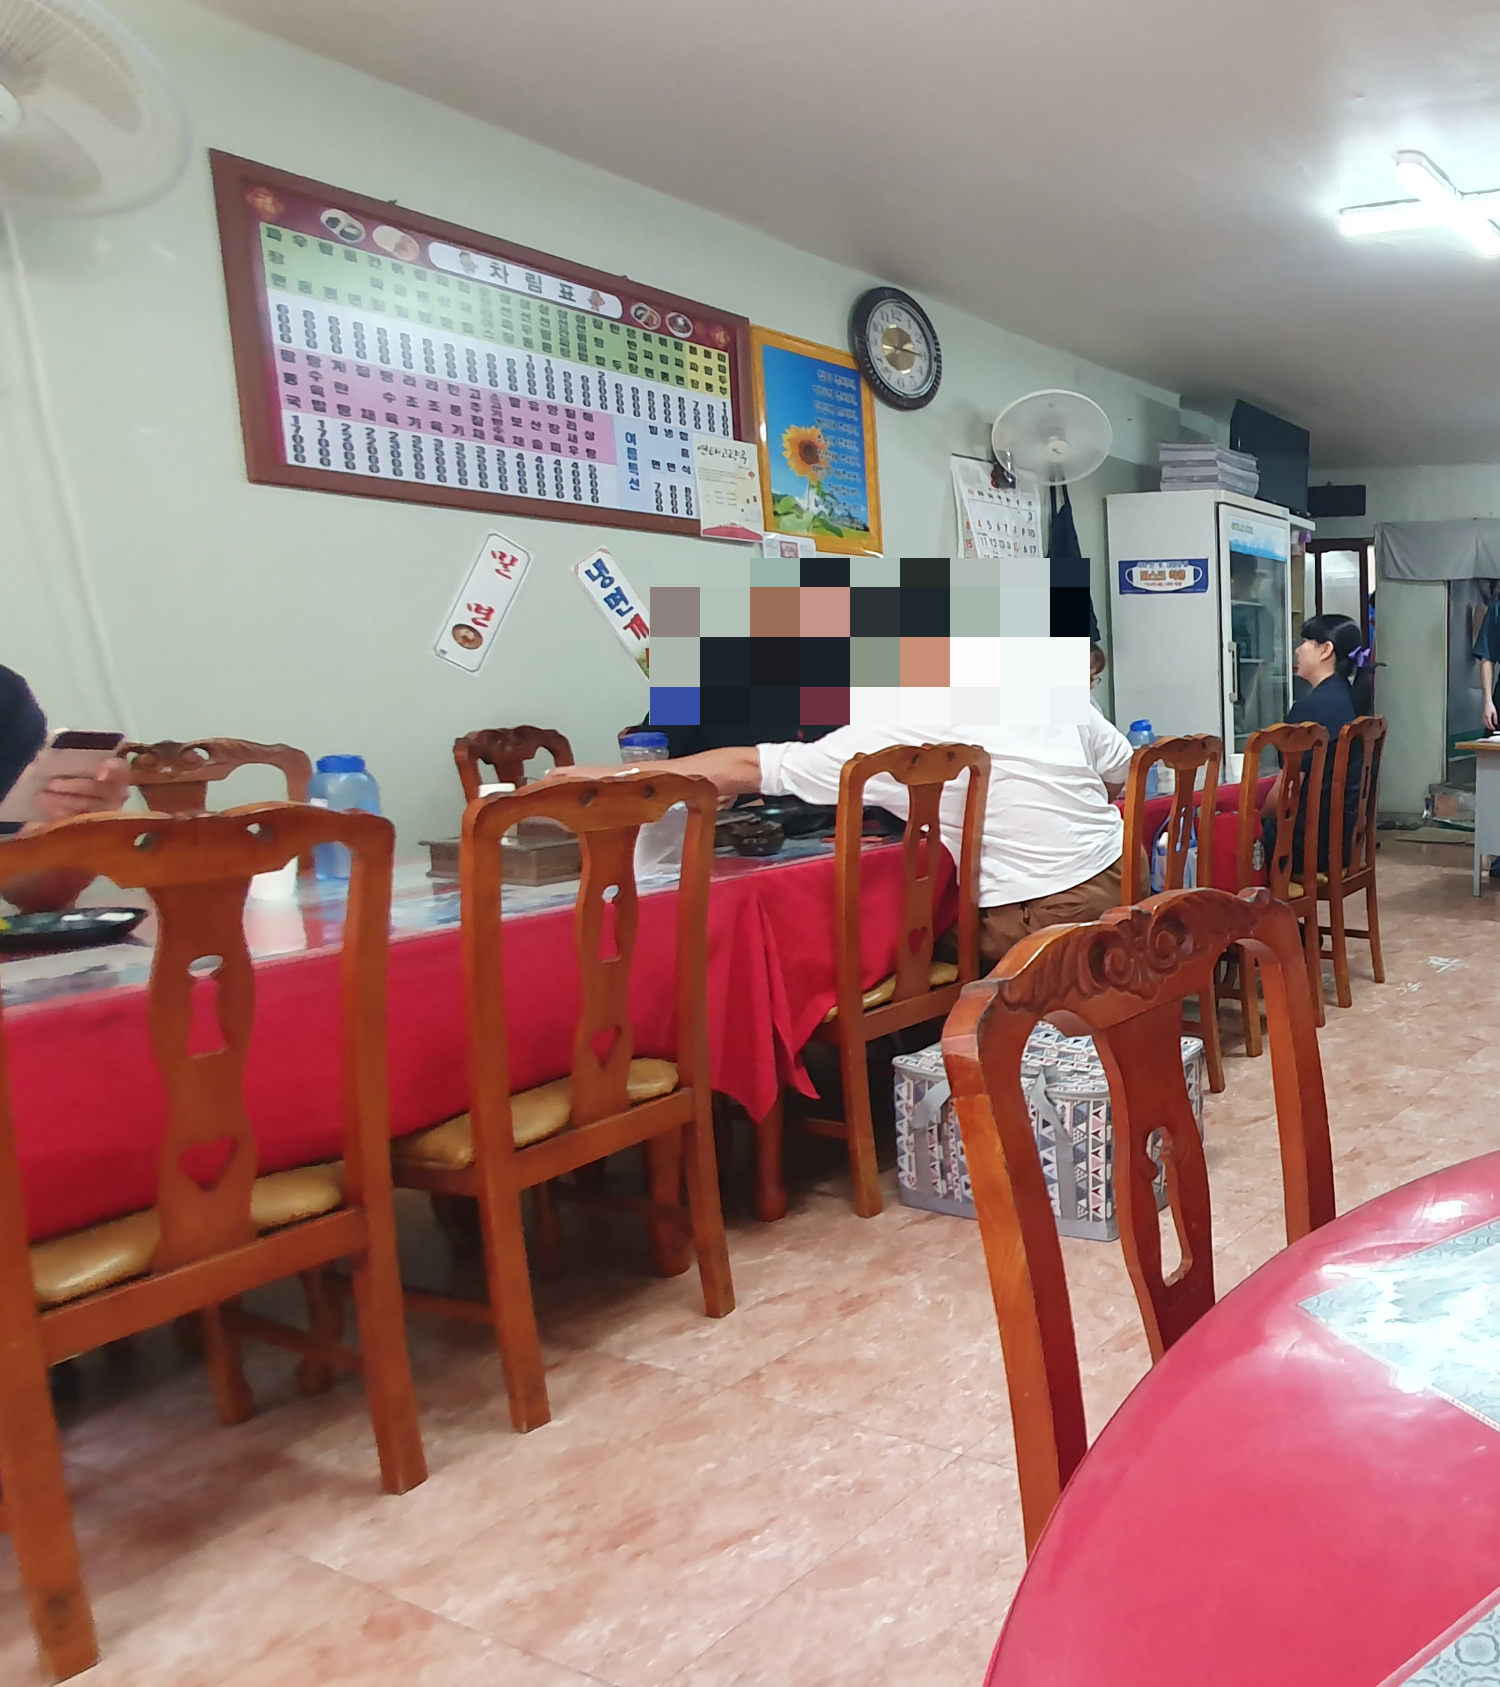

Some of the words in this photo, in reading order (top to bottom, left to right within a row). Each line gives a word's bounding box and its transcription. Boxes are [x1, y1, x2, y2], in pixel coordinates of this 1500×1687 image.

[489, 262, 577, 302] 차림표
[528, 400, 543, 450] 유산슬
[624, 431, 641, 491] 여름특선
[697, 443, 748, 465] 연태고량주
[467, 550, 519, 628] 밀면
[585, 558, 634, 617] 냉면
